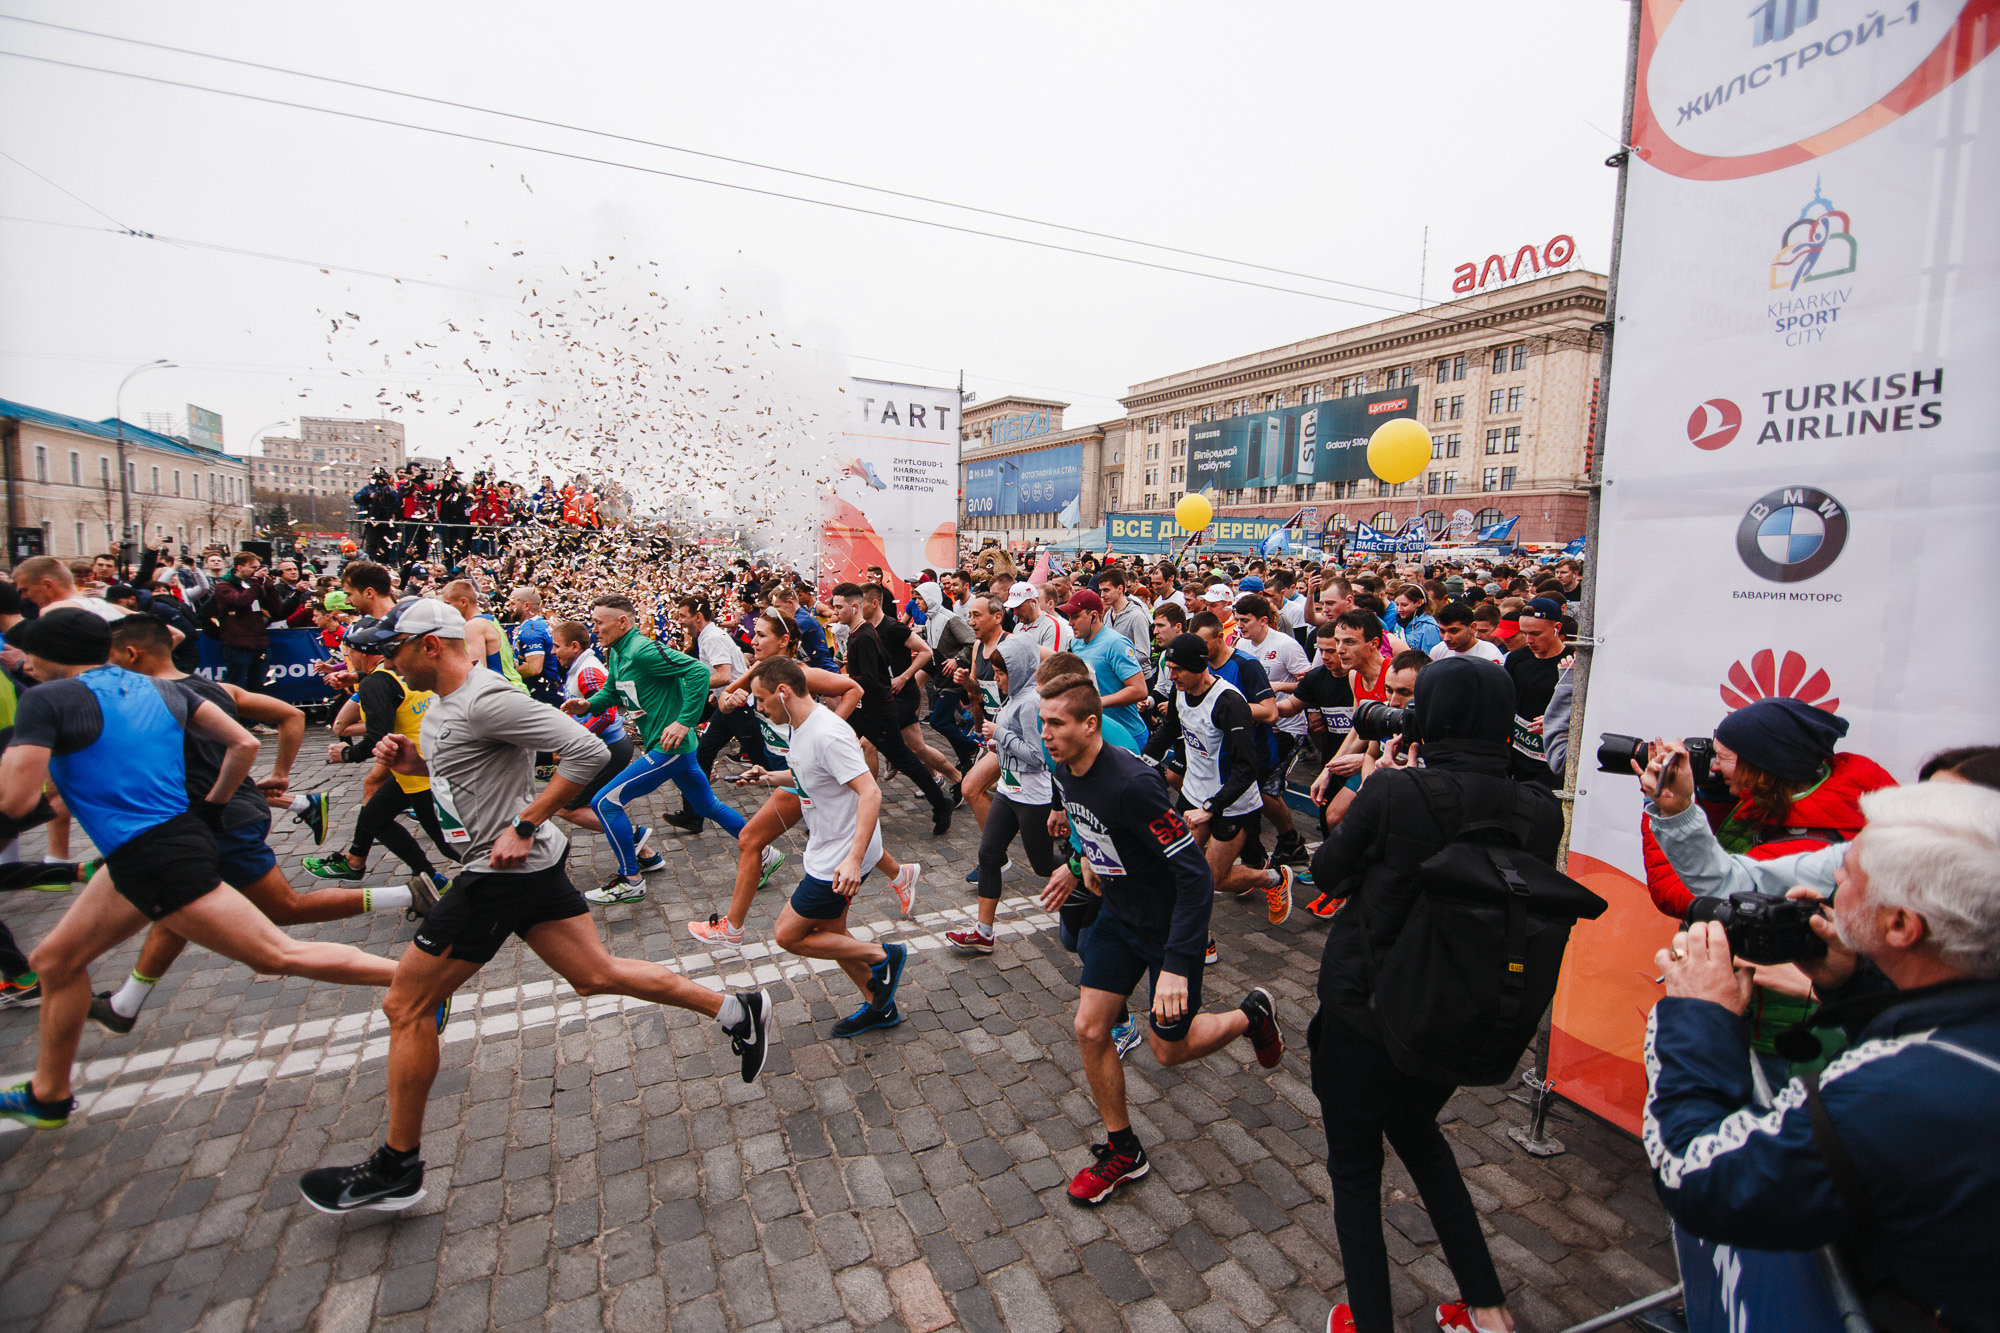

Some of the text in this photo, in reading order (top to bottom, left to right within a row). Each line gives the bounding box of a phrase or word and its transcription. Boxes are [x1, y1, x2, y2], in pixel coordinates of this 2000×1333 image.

[1676, 2, 1920, 127] ЖИЛСТРОЙ-1
[1767, 287, 1853, 318] KHARKIV
[1775, 307, 1841, 333] SPORT
[1785, 327, 1827, 347] CITY
[1762, 367, 1944, 415] TURKISH
[857, 396, 951, 431] TART
[1369, 400, 1407, 413] ЦИТРУС
[991, 407, 1051, 445] MEIZU
[1756, 401, 1942, 445] AIRLINES
[1195, 430, 1220, 440] SAMSUNG
[1326, 440, 1352, 450] Galaxy
[893, 457, 943, 468] ZHYTLOBUD-1
[893, 466, 926, 475] KHARKIV
[893, 475, 949, 486] INTERNATIONAL
[893, 484, 934, 492] MARATHON
[1749, 488, 1842, 522] BMW
[1112, 519, 1153, 538] ВСЕ
[1356, 540, 1394, 552] ВМЕСТЕ
[1732, 590, 1843, 603] БАВАРИЯ МОТОРС
[1326, 716, 1351, 727] 5133
[1514, 729, 1540, 748] 2464
